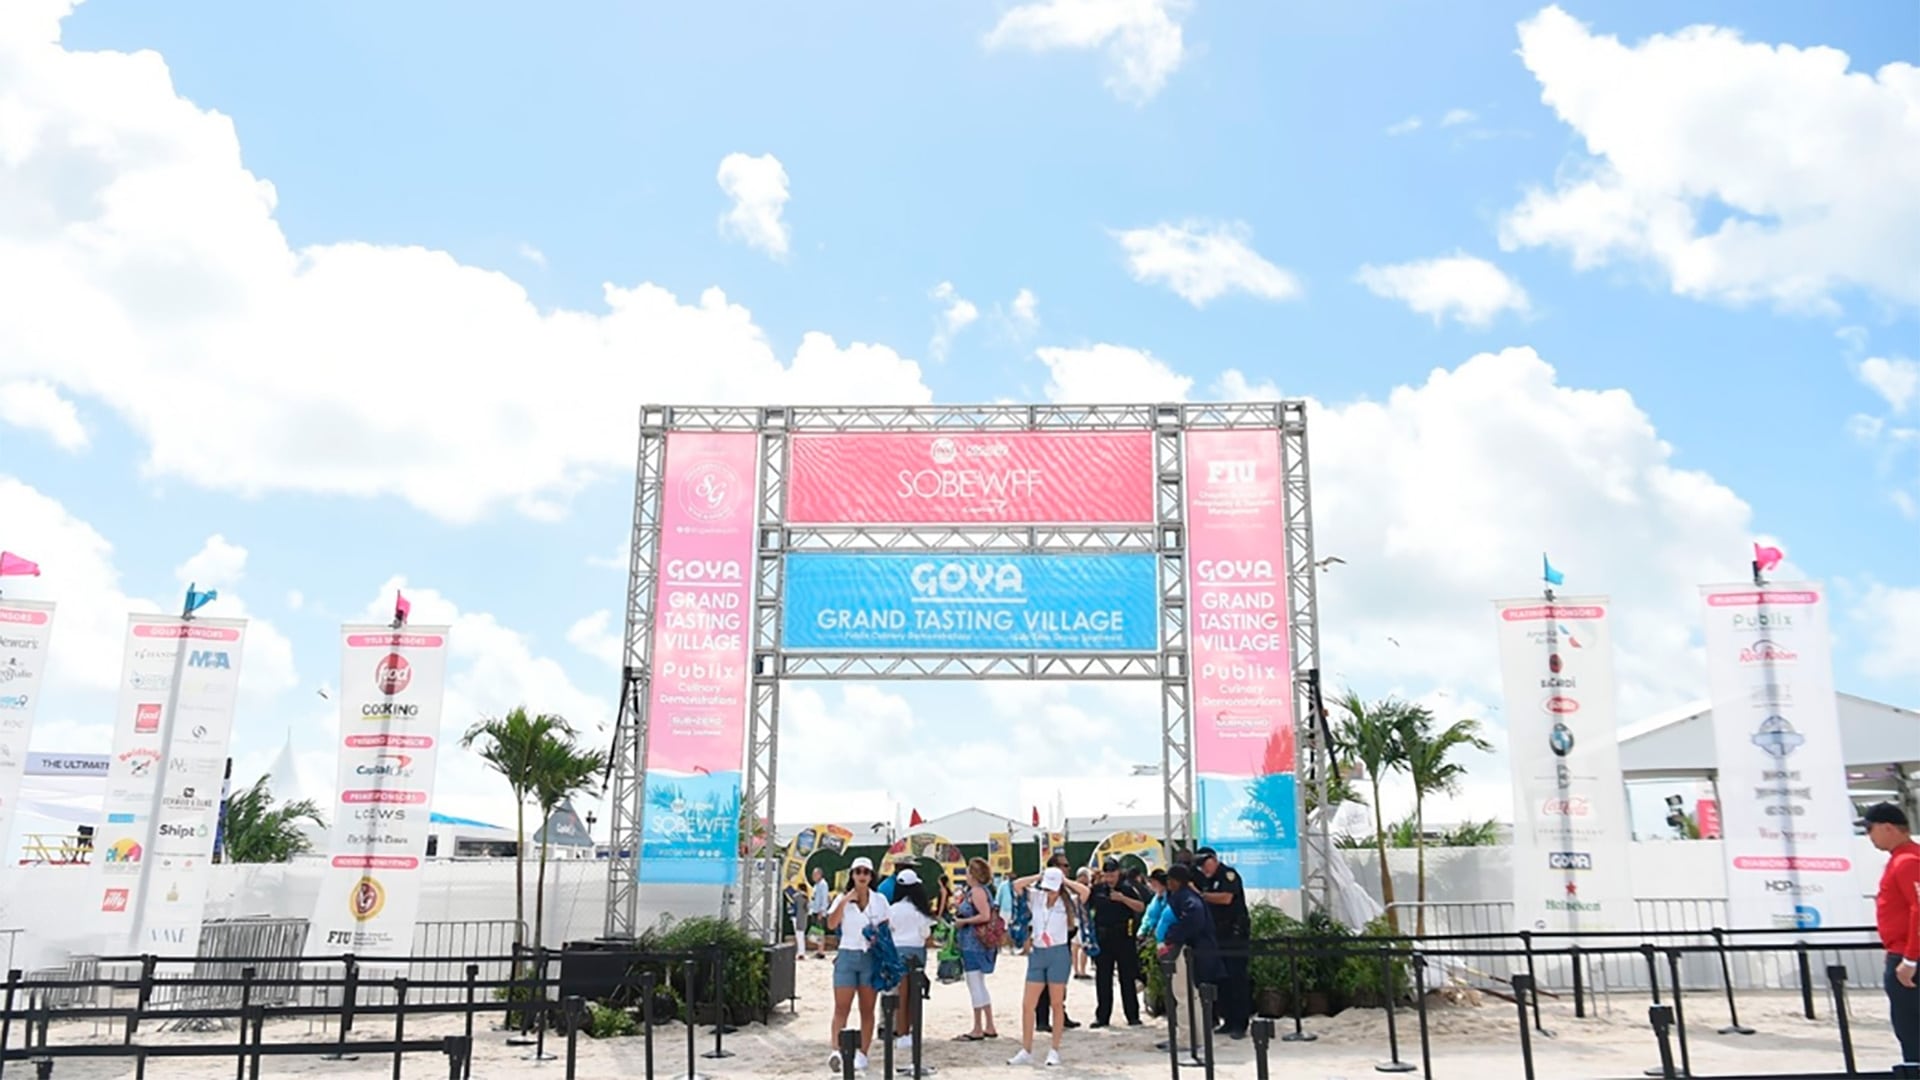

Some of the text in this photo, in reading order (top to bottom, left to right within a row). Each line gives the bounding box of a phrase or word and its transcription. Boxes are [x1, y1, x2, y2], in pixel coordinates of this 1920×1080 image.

[1207, 460, 1256, 483] FIU
[897, 468, 1042, 498] SOBEWFF
[667, 559, 741, 581] GOYA
[1196, 559, 1274, 581] GOYA
[911, 563, 1023, 596] GOYA
[668, 591, 740, 609] GRAND
[1201, 592, 1275, 609] GRAND
[664, 612, 741, 630] TASTING
[816, 608, 1123, 631] GRAND TASTING VILLAGE
[1199, 613, 1279, 631] TASTING
[1732, 611, 1793, 625] Publix
[662, 633, 741, 651] VILLAGE
[1200, 634, 1281, 652] VILLAGE
[662, 660, 735, 679] Publix
[1202, 662, 1275, 680] Publix
[361, 702, 419, 716] COOKING
[41, 758, 62, 768] THE
[159, 823, 195, 838] Shipt
[1550, 854, 1589, 868] GOYA
[1545, 898, 1602, 912] Heineken
[326, 929, 352, 944] FIU
